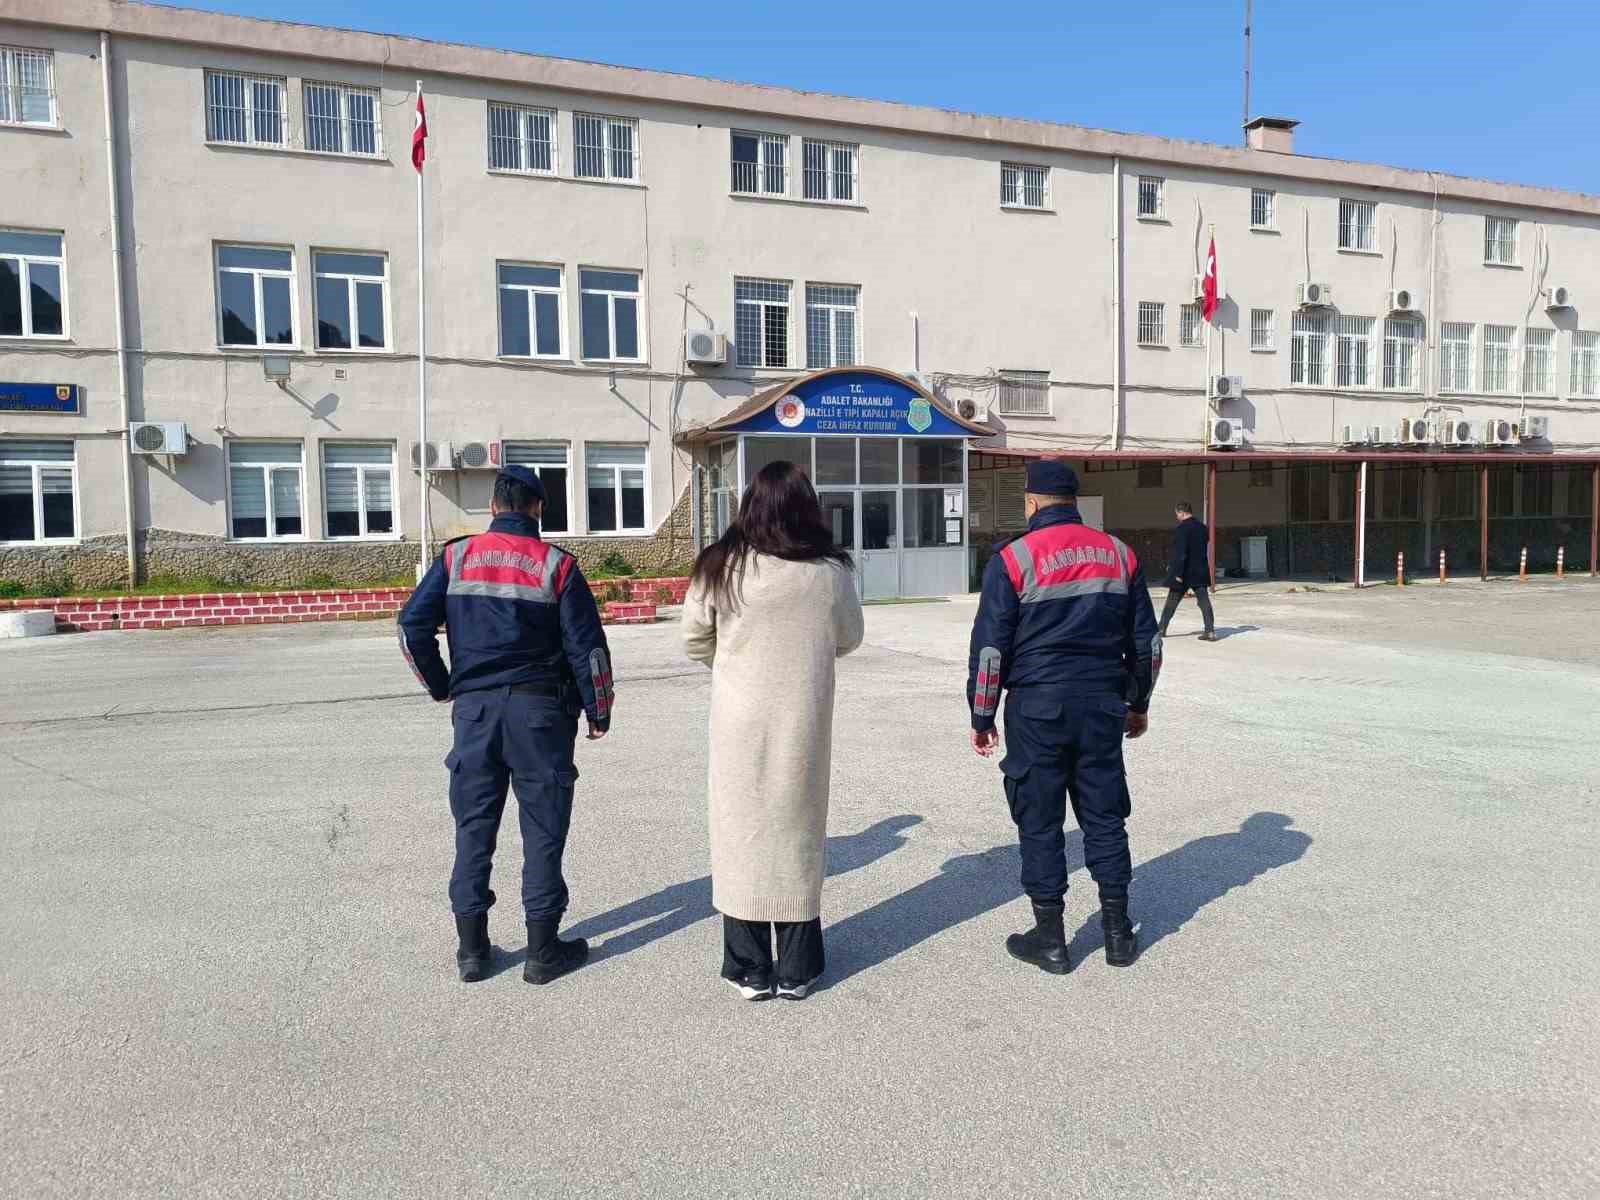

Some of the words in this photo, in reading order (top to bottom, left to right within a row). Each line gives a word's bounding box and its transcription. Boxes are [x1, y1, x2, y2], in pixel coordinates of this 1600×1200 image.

[849, 384, 864, 393] T.C.
[821, 396, 851, 405] ADALET
[853, 396, 893, 406] BAKANLIĞI
[805, 406, 835, 417] NAZİLLİ
[837, 408, 842, 417] E
[861, 408, 888, 418] KAPALI
[817, 421, 837, 430] CEZA
[1040, 546, 1116, 576] JANDARMA
